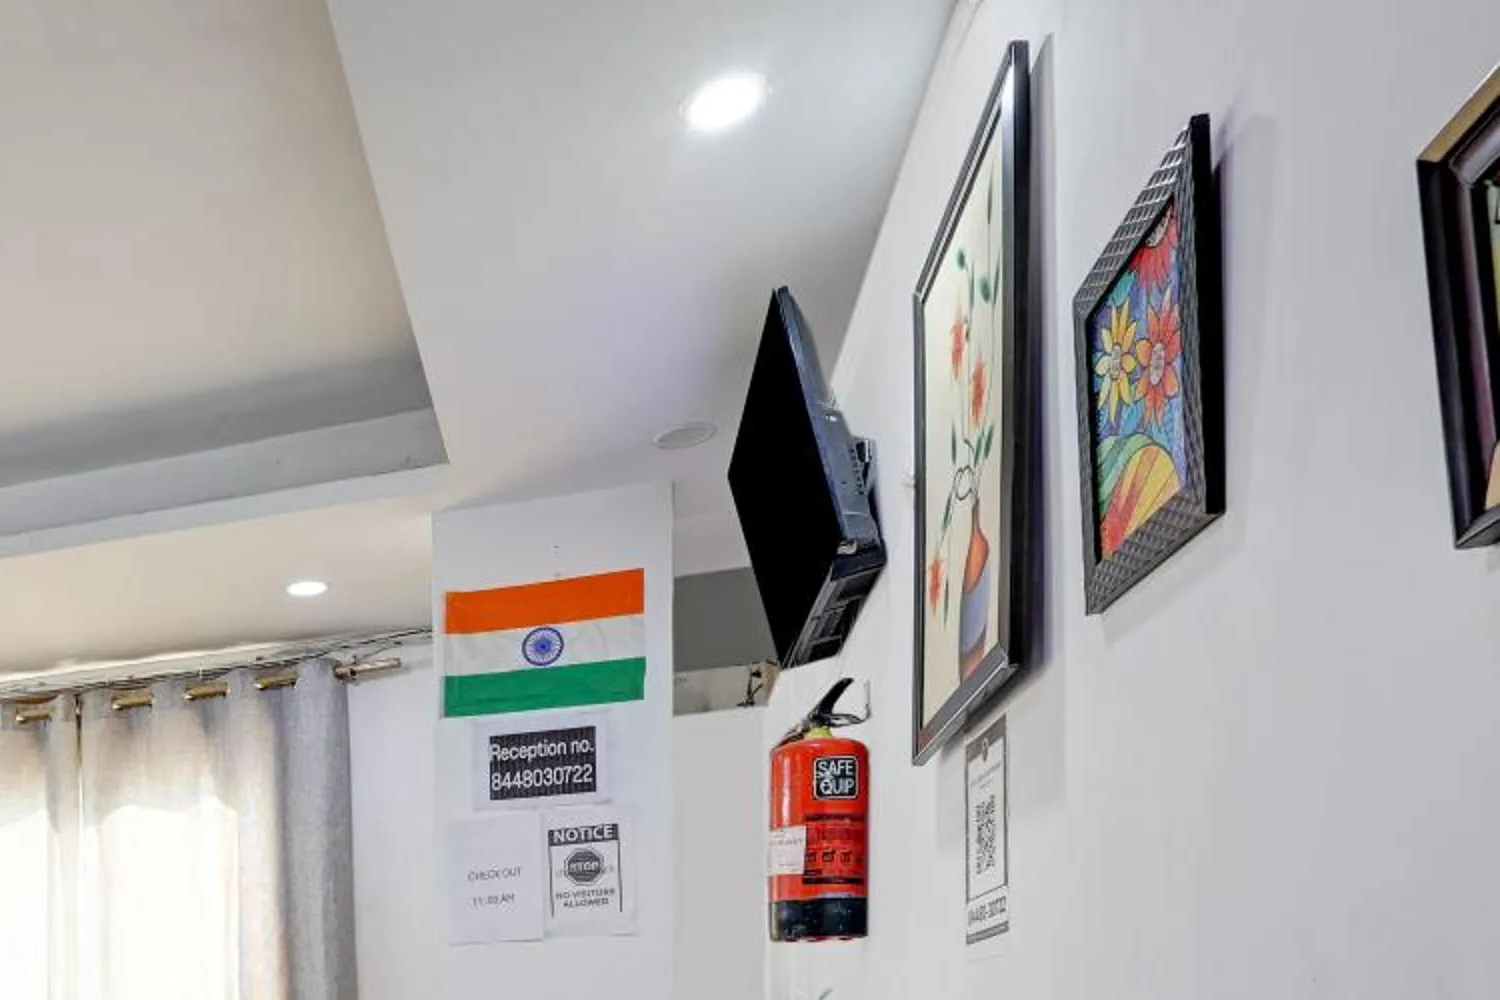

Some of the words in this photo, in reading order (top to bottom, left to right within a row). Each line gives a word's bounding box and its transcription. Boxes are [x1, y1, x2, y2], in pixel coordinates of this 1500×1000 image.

[490, 739, 567, 762] Reception
[571, 739, 595, 754] no.
[818, 760, 854, 775] SAFE
[491, 763, 594, 791] 8448030722
[820, 778, 855, 795] QUIP
[553, 824, 614, 843] NOTICE
[467, 868, 500, 882] CHECK
[501, 866, 521, 879] OUT
